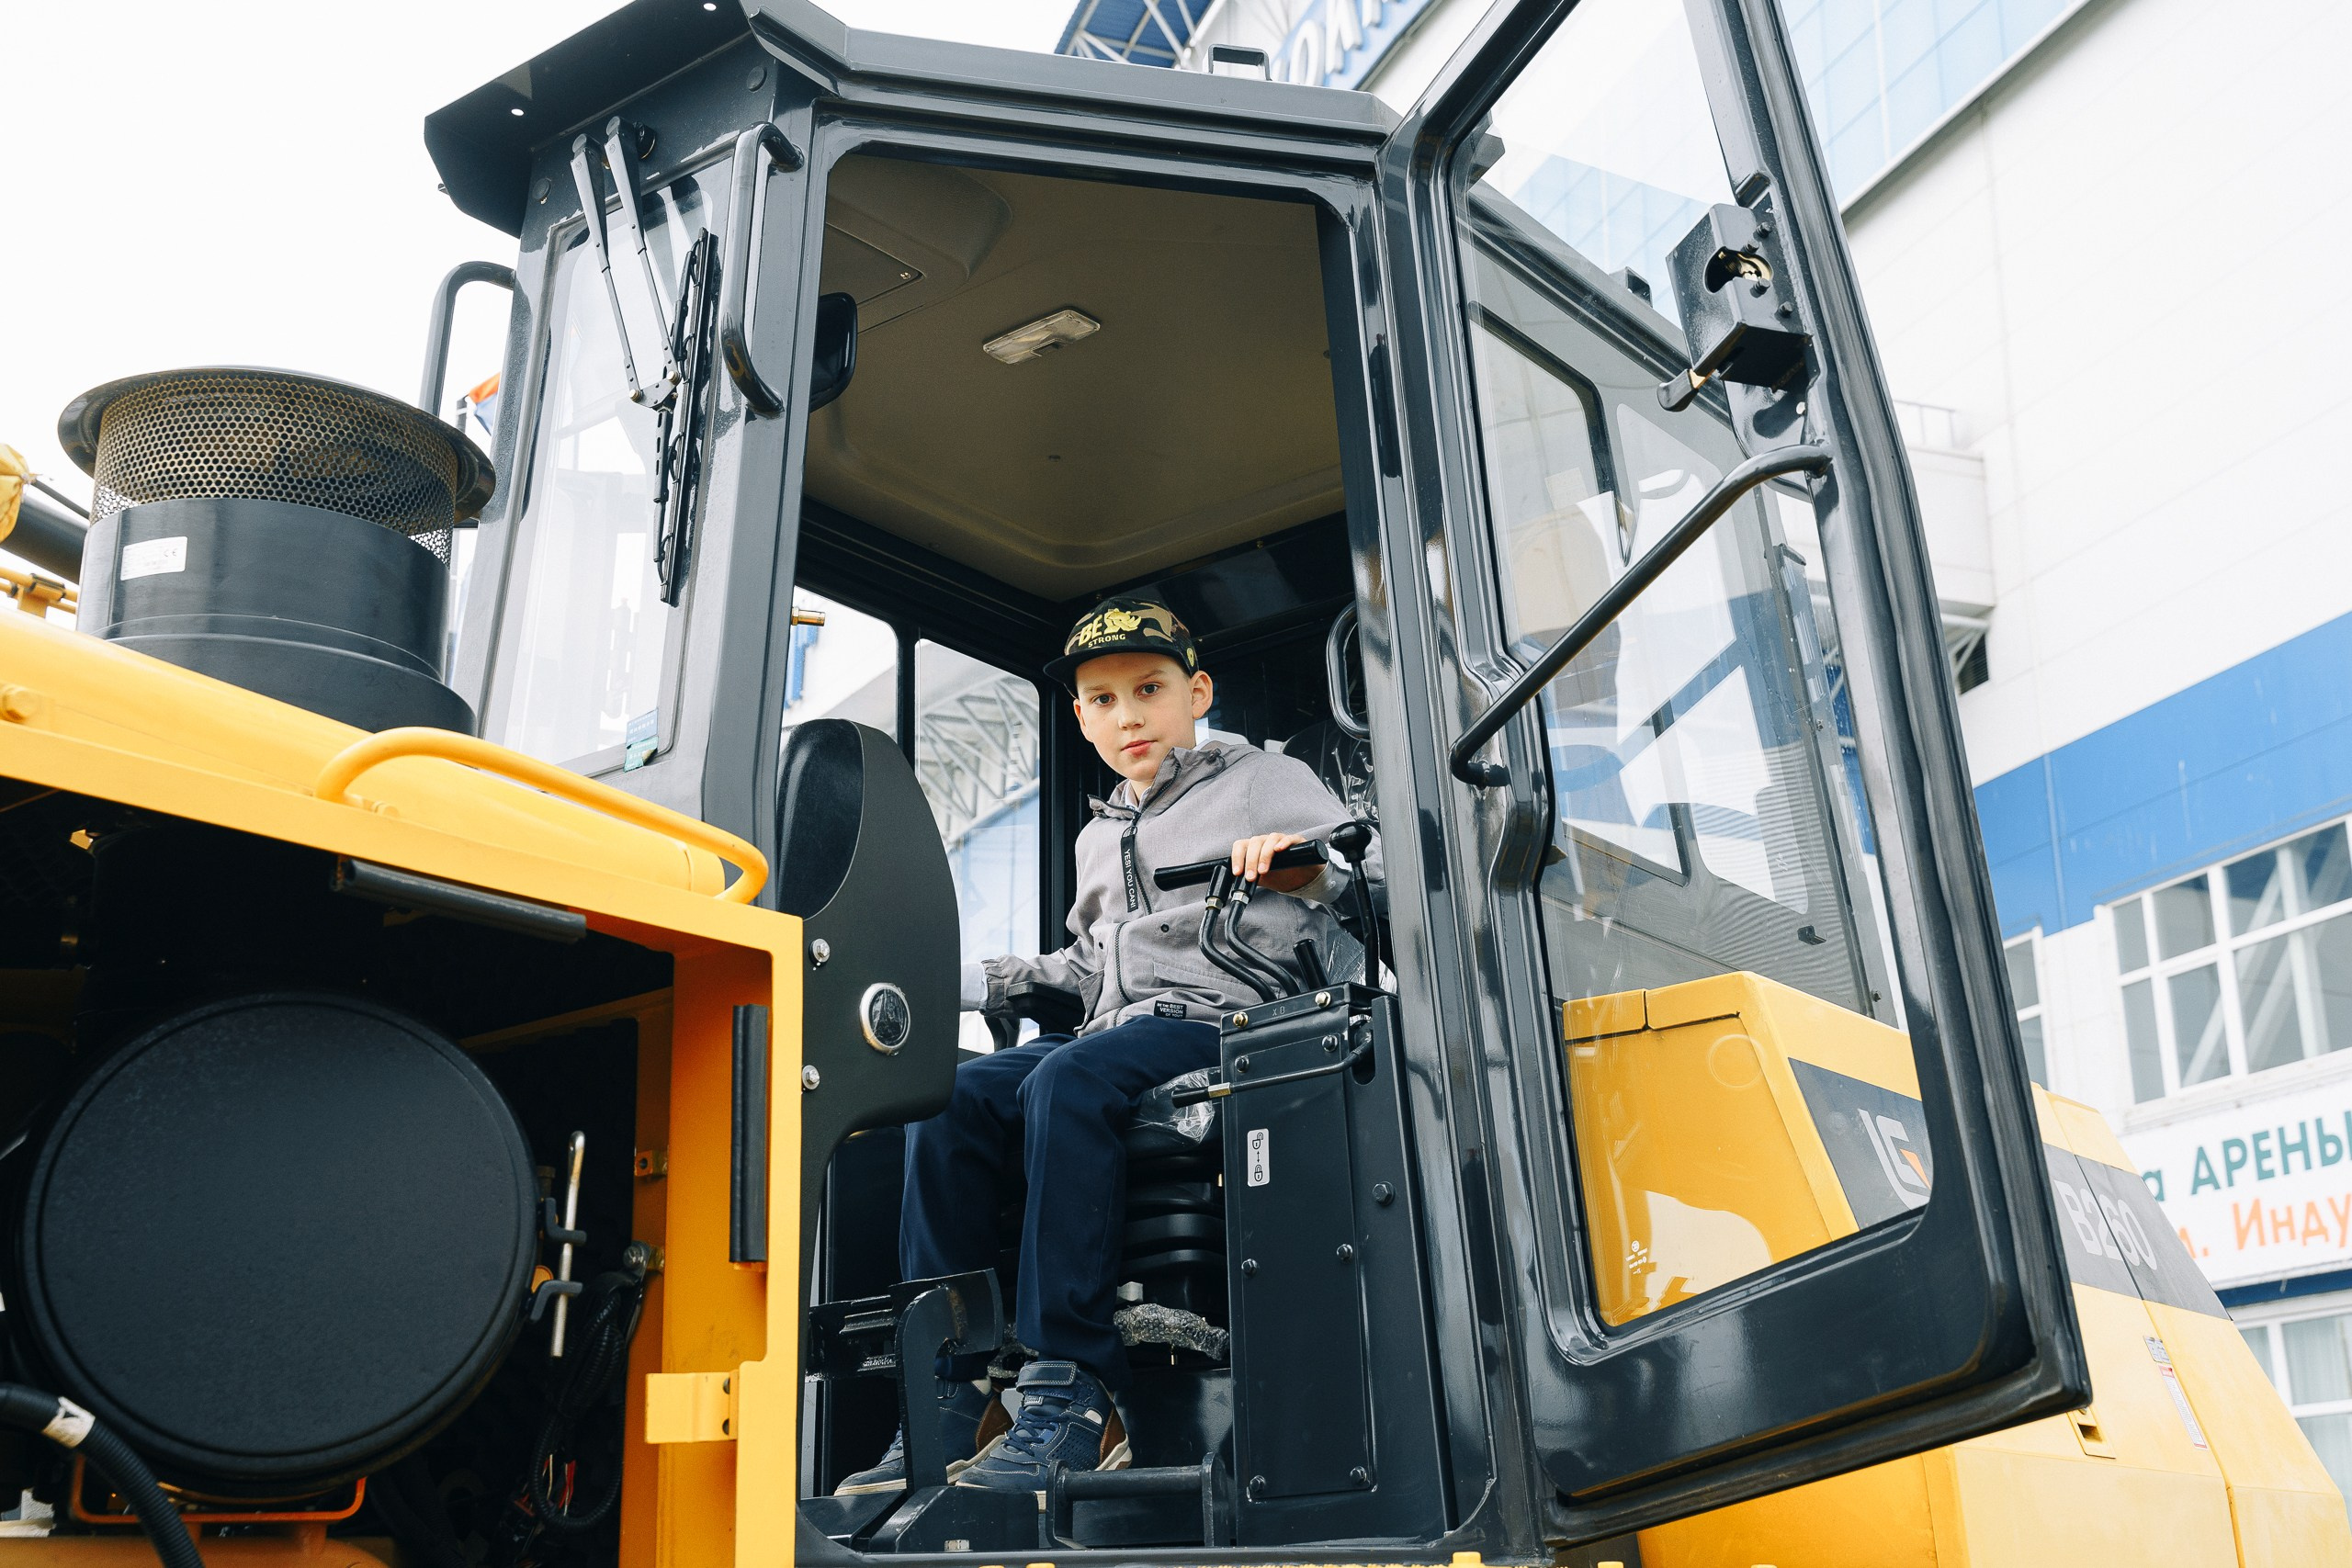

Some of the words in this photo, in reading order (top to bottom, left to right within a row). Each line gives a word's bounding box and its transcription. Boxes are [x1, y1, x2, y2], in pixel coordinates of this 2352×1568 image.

[1078, 614, 1102, 647] BE
[1088, 633, 1126, 649] STRONG
[1125, 868, 1134, 887] YOU
[2190, 1111, 2352, 1195] АРЕНЫ
